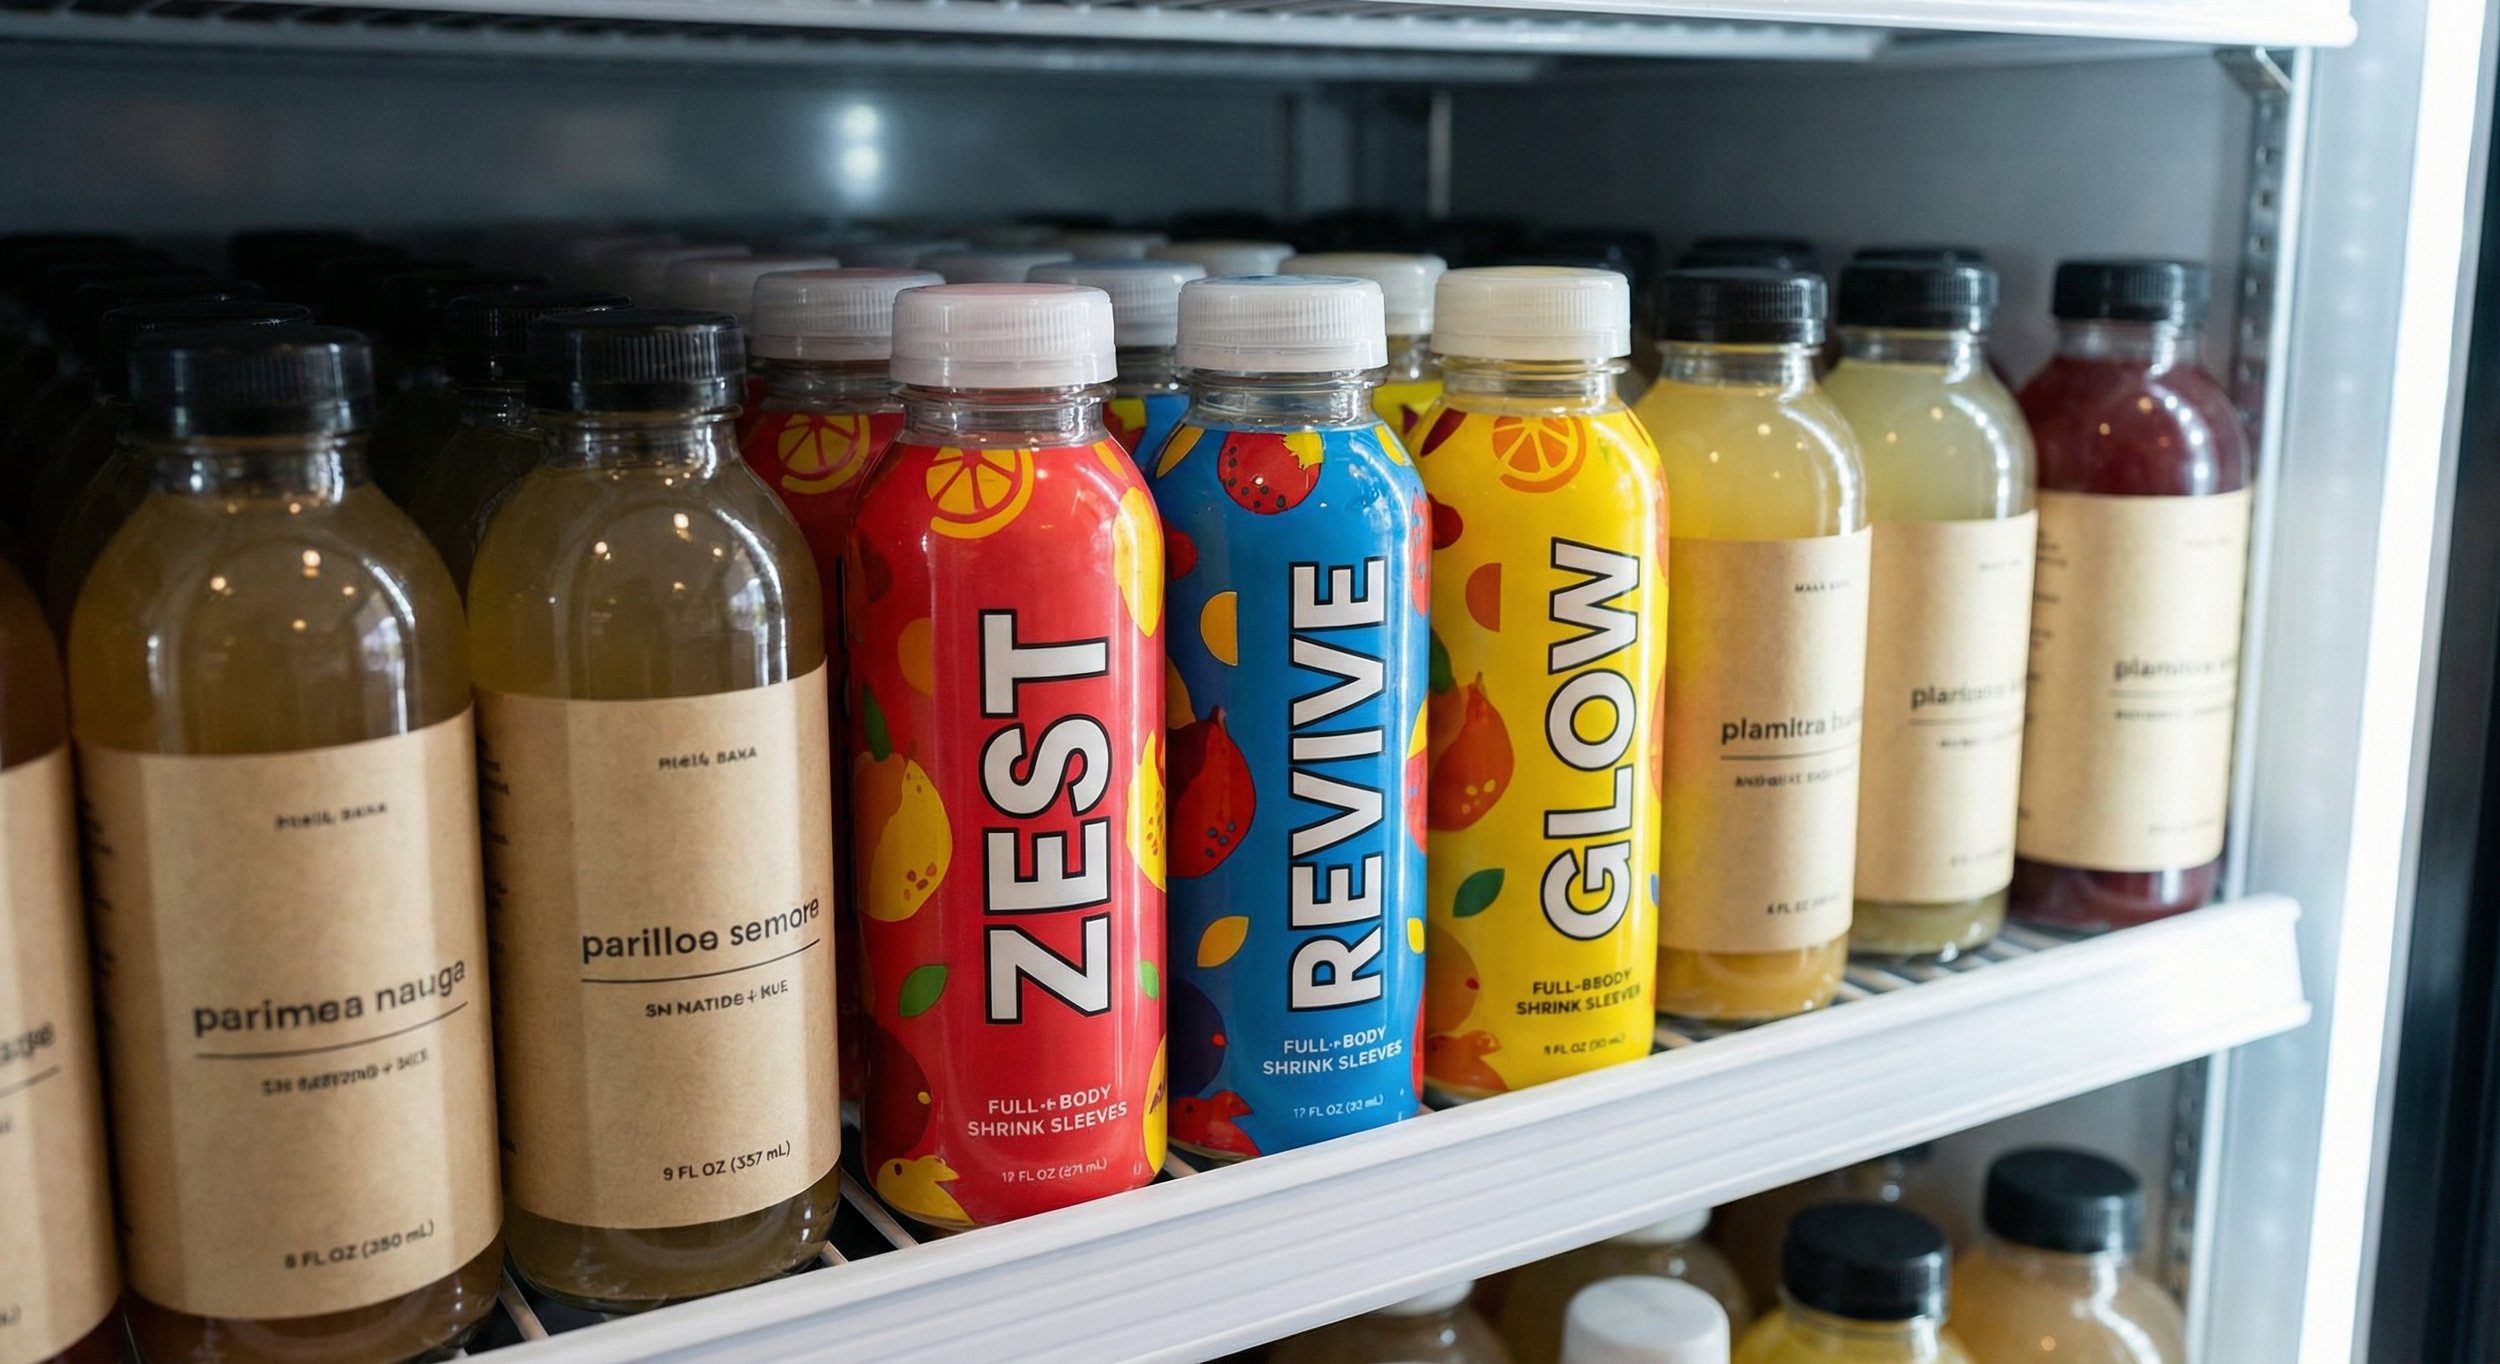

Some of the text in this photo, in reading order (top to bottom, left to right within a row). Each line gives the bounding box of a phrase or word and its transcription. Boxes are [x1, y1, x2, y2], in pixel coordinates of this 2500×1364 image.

[1540, 537, 1641, 941] GLOW
[1721, 716, 1826, 745] plamitra
[1289, 556, 1388, 1012] REVIVE
[978, 609, 1112, 1024] ZEST
[582, 898, 820, 964] parilloe semore
[194, 960, 466, 1037] parimea nauga
[1516, 999, 1581, 1015] SHRINK
[1263, 1039, 1402, 1075] SHRINK SLEEVES
[1554, 1044, 1568, 1054] FL
[1570, 1041, 1587, 1053] OZ
[967, 1101, 1128, 1137] SHRINK SLEEVES
[1309, 1106, 1323, 1117] FL
[1326, 1103, 1344, 1116] OZ
[663, 1167, 673, 1181] 9
[678, 1164, 699, 1180] FL
[702, 1160, 726, 1176] OZ
[766, 1139, 791, 1161] mL)
[1019, 1170, 1034, 1182] FL
[1037, 1168, 1056, 1180] OZ
[302, 1250, 326, 1267] FL
[329, 1244, 357, 1262] OZ
[406, 1218, 434, 1243] mL)
